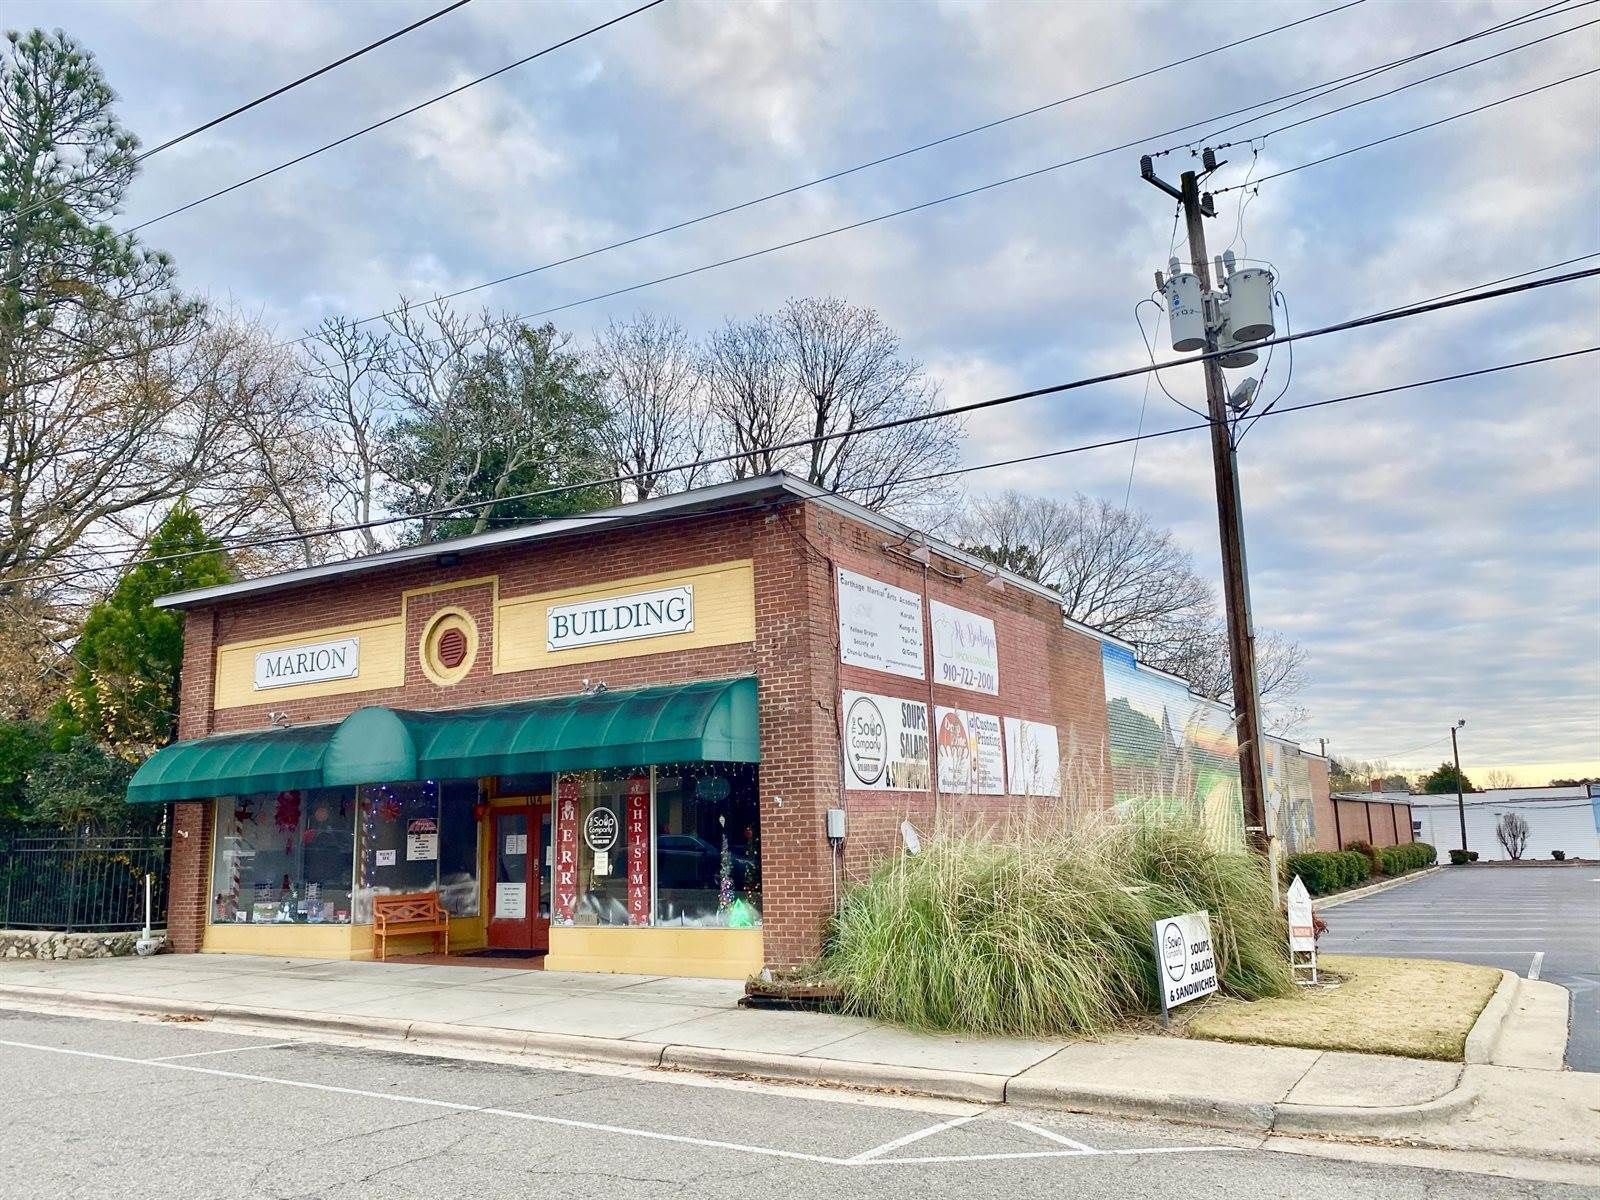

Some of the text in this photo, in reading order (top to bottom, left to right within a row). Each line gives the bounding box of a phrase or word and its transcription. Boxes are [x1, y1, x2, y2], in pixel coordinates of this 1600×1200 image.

[553, 597, 686, 639] BUILDING
[265, 647, 346, 678] MARION
[943, 663, 994, 691] 910-722-2001
[857, 715, 882, 741] Soup
[852, 736, 881, 751] Company
[900, 732, 929, 761] SALADS
[594, 815, 614, 829] Soup
[560, 810, 575, 906] MERRY
[632, 796, 643, 911] CHRISTMAS
[1191, 957, 1214, 975] SALADS
[1175, 976, 1216, 1000] SANDWICHES
